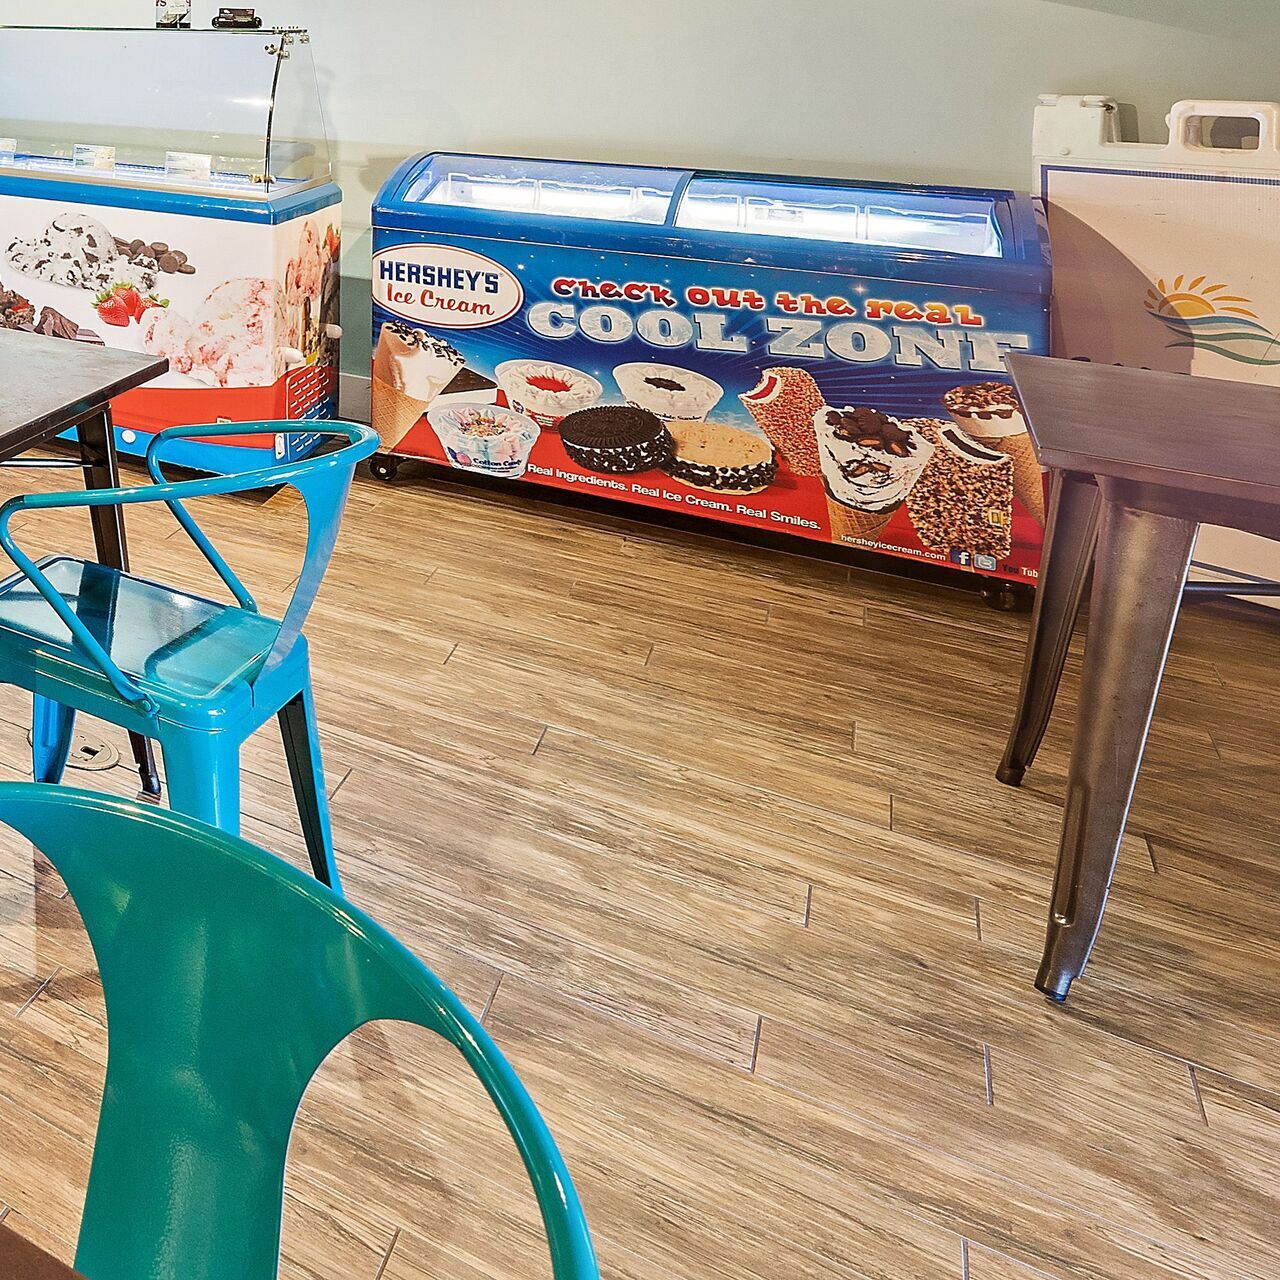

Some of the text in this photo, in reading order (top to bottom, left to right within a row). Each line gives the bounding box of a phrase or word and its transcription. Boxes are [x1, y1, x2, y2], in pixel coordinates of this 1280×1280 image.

[380, 260, 499, 294] HERSHEY'S
[387, 283, 495, 316] Ice Cream
[687, 286, 764, 311] out
[776, 293, 856, 317] the
[866, 298, 984, 326] real
[527, 302, 747, 354] COOL
[527, 463, 822, 530] Real Ingredients. Real Ice Cream. Real Smiles.
[841, 534, 946, 561] hersheyicecream.com
[1021, 567, 1039, 578] Tub
